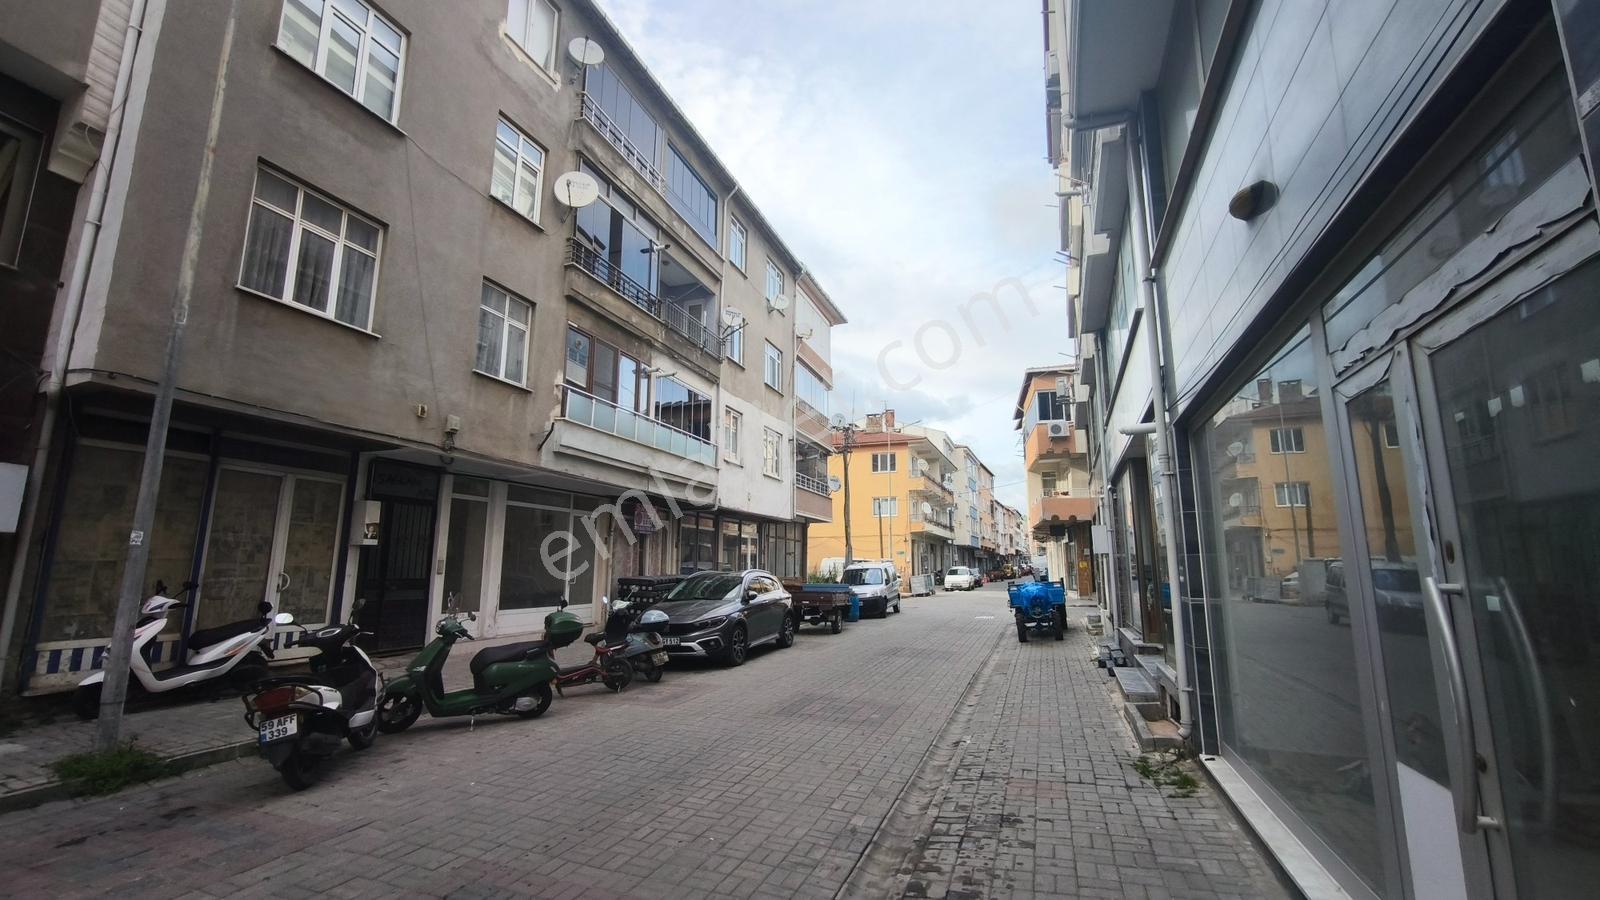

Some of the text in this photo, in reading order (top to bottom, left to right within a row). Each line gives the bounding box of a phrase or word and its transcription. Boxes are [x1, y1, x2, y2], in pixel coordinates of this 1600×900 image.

[261, 714, 296, 732] 59 AFF
[268, 726, 288, 740] 339
